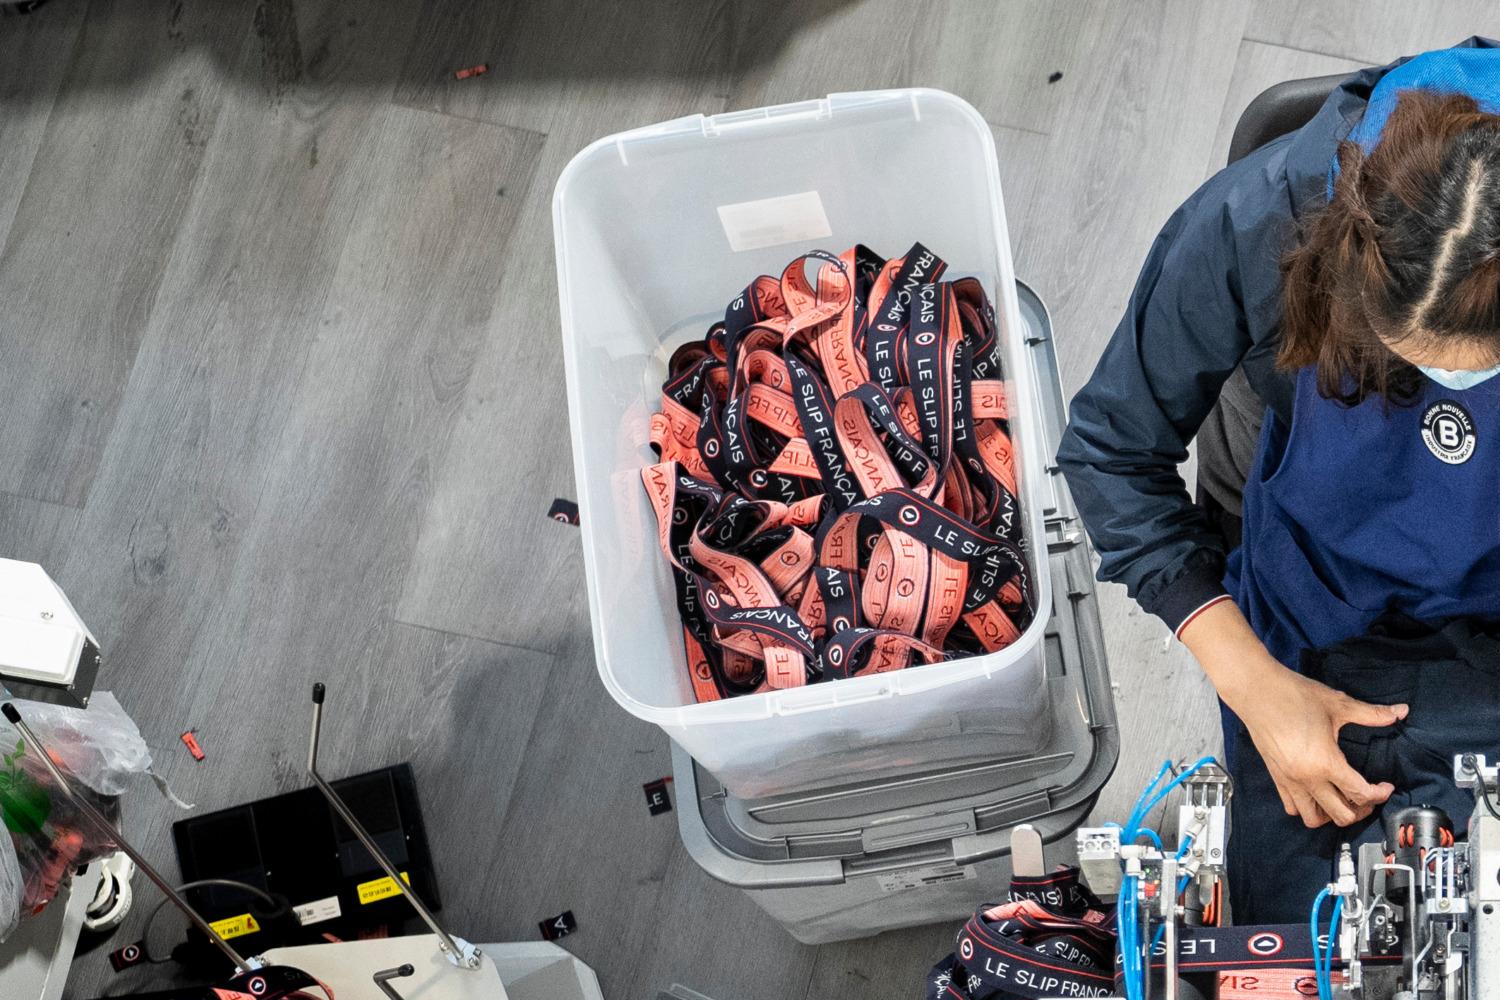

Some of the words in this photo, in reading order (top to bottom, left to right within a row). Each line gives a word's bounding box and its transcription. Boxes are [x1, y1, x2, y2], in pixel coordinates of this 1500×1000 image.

[887, 250, 934, 322] FRANÇAIS
[920, 283, 935, 324] NÇAIS
[876, 340, 889, 361] LE
[879, 367, 893, 393] SL
[917, 358, 932, 381] LE
[872, 394, 890, 416] LE
[922, 388, 938, 428] SLIP
[1424, 405, 1440, 425] BONNE
[1442, 404, 1471, 430] NOUVELLE
[726, 398, 745, 464] NÇAIS
[789, 359, 807, 379] LE
[801, 383, 824, 424] SLIP
[815, 426, 857, 507] FRANÇA
[955, 418, 967, 442] LE
[1439, 420, 1459, 446] B
[934, 525, 959, 546] LE
[1180, 938, 1216, 955] LE
[985, 957, 1010, 978] LE
[1014, 970, 1058, 992] SLIP
